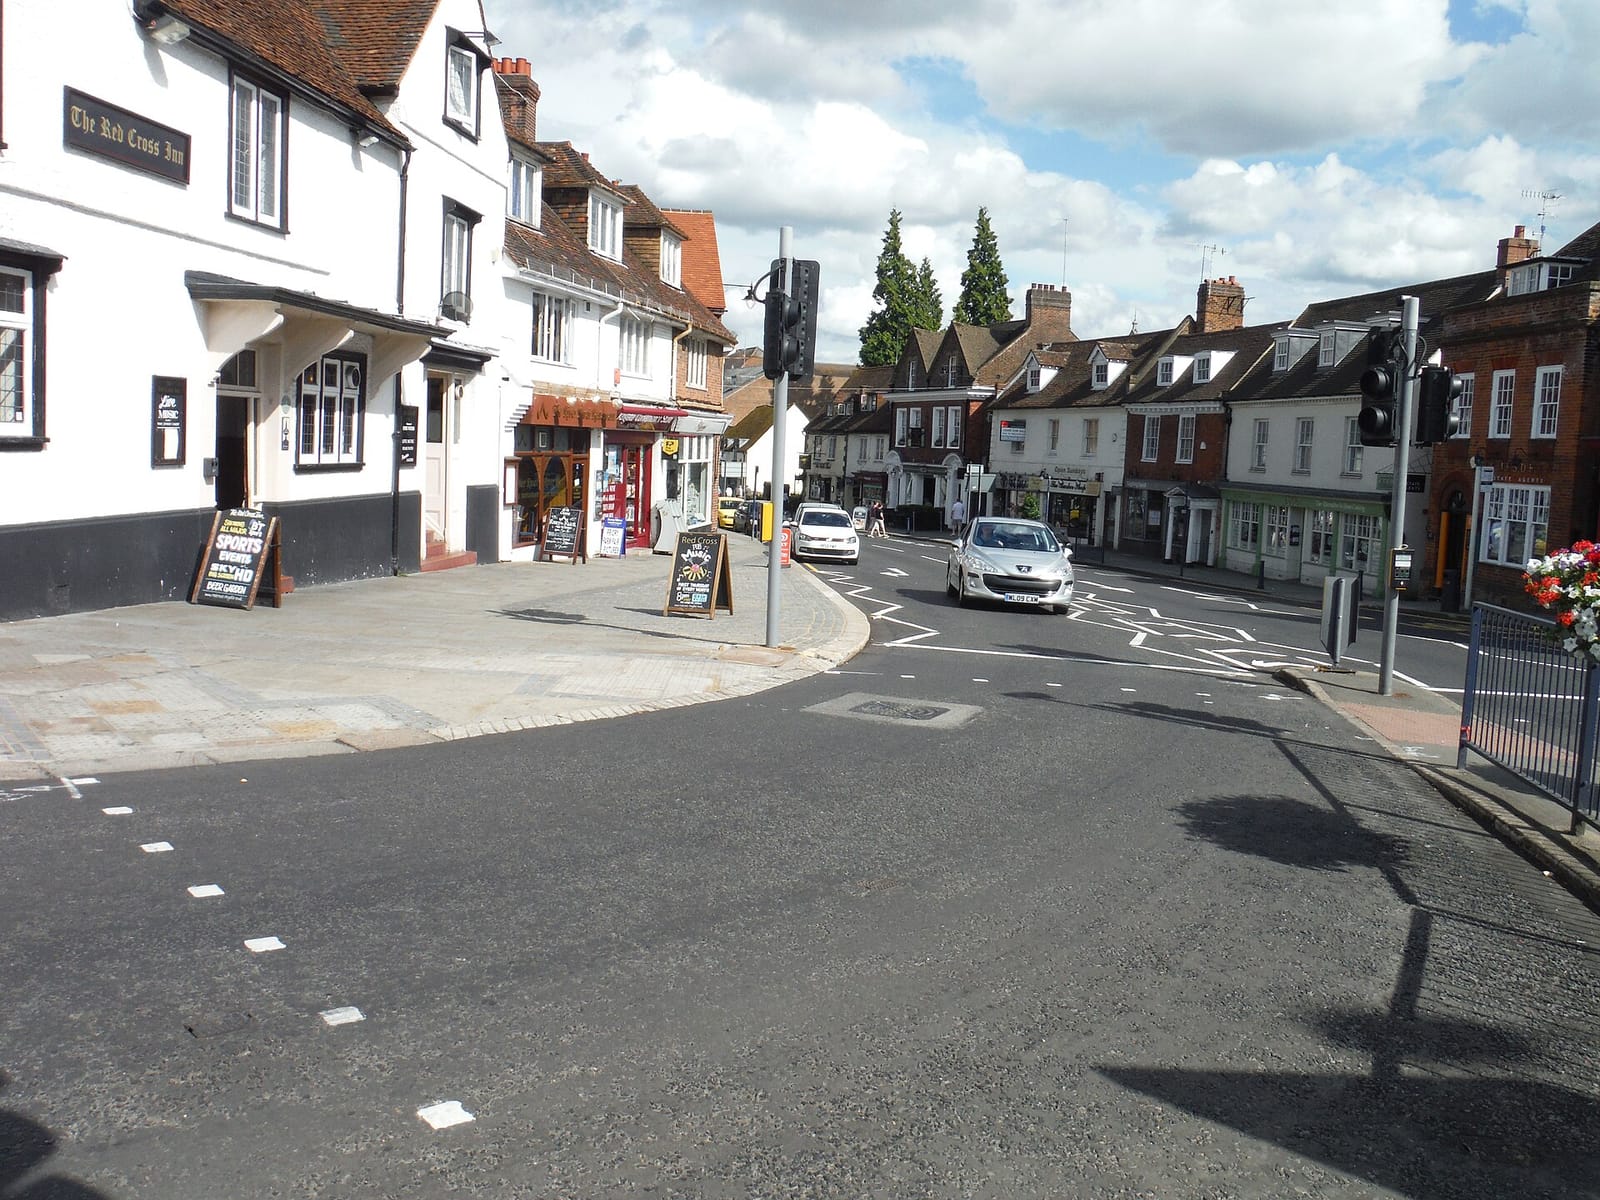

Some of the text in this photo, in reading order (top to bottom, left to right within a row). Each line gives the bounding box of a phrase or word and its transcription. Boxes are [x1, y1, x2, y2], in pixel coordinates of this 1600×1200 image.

[70, 105, 184, 165] The Red Cross Inn
[216, 535, 263, 553] SPORTS
[681, 536, 718, 545] Red Cross
[219, 551, 252, 563] EVENTS
[211, 563, 254, 582] SKY HD
[206, 580, 247, 595] BEER GARDEN
